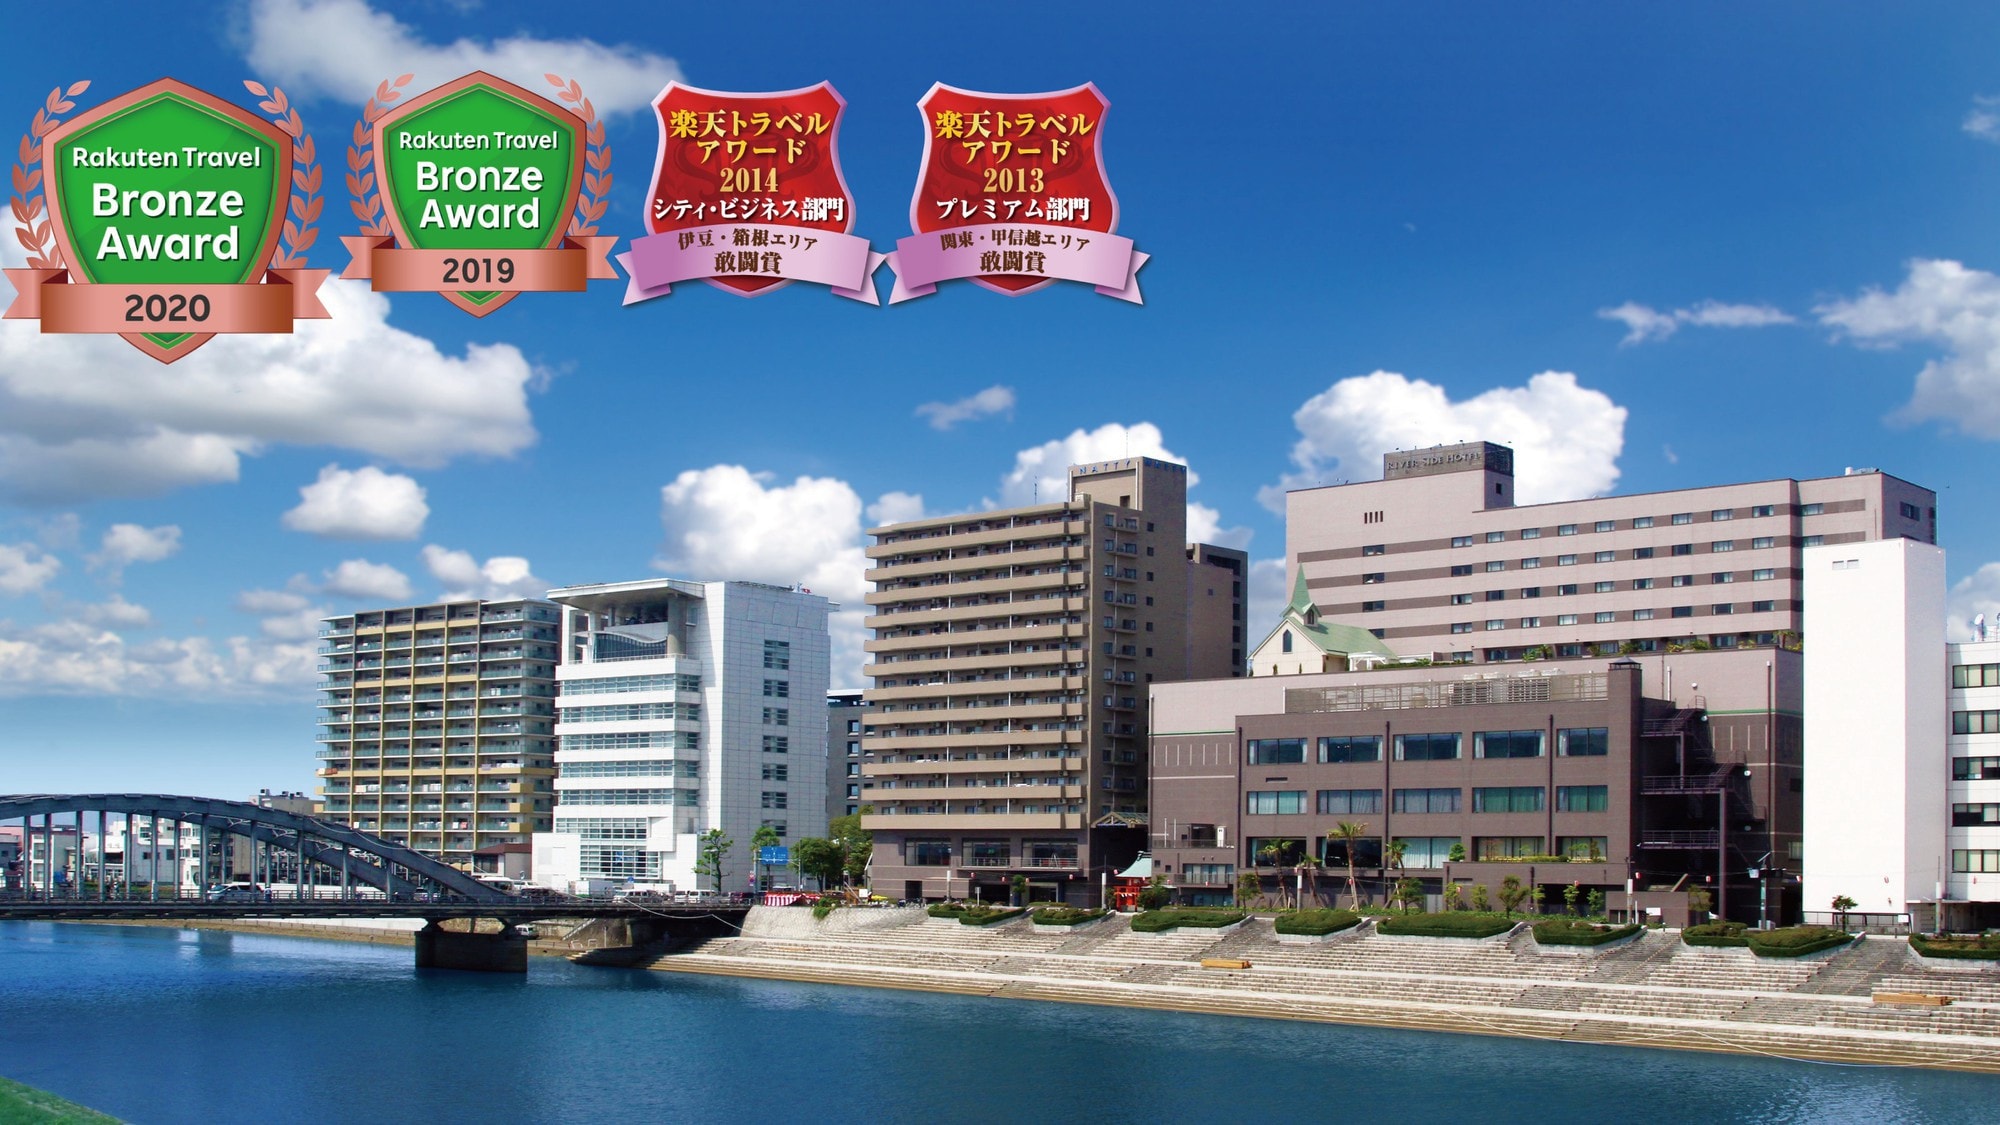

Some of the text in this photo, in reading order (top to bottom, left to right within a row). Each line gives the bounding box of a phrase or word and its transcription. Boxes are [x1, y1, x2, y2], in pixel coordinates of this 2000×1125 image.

[1387, 452, 1481, 471] RIVER SIDE HOTEL
